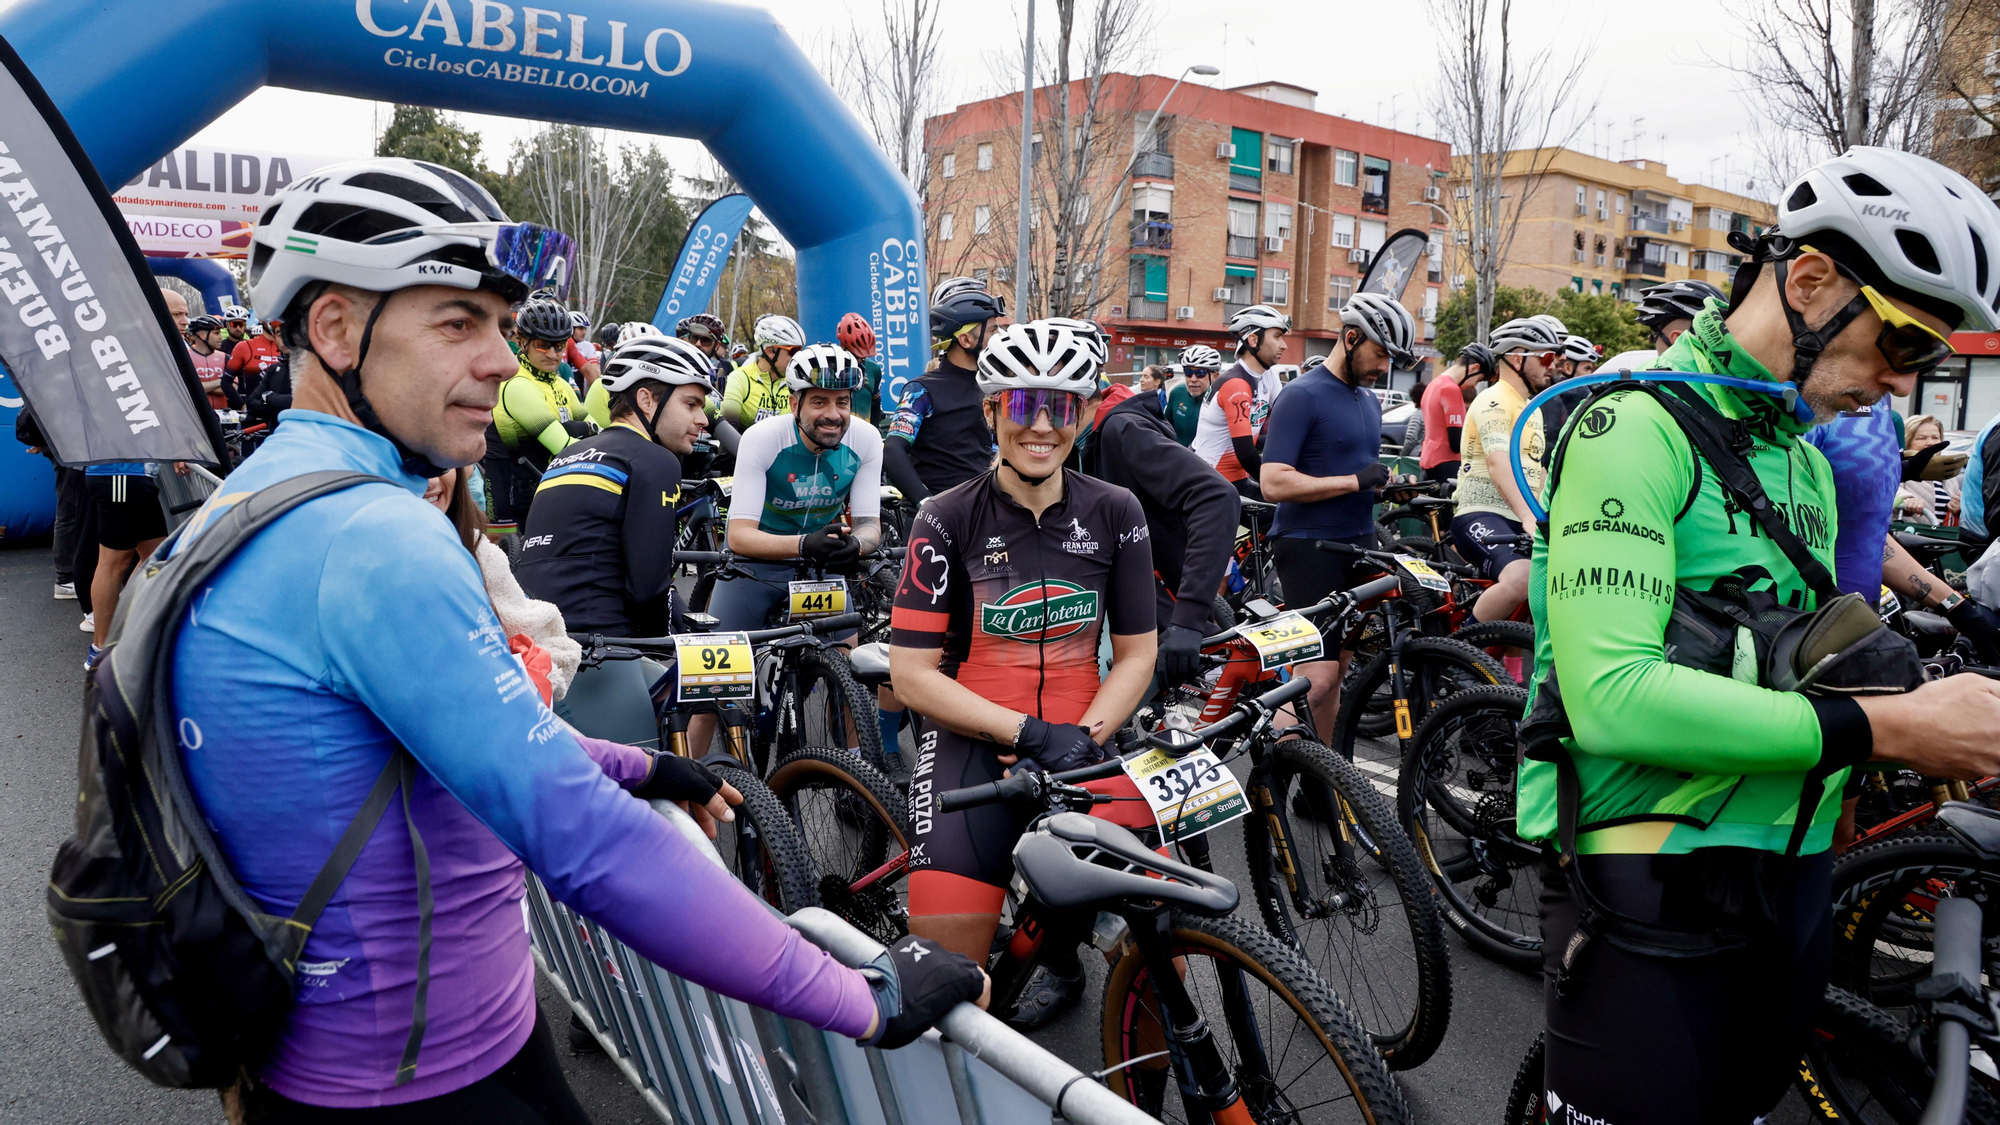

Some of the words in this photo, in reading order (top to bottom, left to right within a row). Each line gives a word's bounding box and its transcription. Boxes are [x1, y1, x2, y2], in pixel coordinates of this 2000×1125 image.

[355, 0, 692, 77] CABELLO
[384, 48, 650, 98] CiclosCABELLO.COM
[1861, 204, 1911, 223] KASK
[418, 264, 453, 276] KASK
[666, 224, 713, 316] CABELLO
[696, 231, 729, 288] Ciclos
[905, 239, 922, 326] Ciclos
[1081, 541, 1099, 550] POZO
[1562, 519, 1590, 537] BICIS
[1592, 519, 1666, 546] GRANADOS
[1551, 567, 1673, 605] AL-ANDALUS
[1559, 588, 1585, 601] CLUB
[1597, 586, 1660, 606] CICLISTA
[801, 594, 833, 611] 441
[1260, 623, 1303, 641] 552
[701, 647, 732, 670] 92
[918, 729, 938, 776] FRAN
[1140, 758, 1170, 775] PREFERENTE
[1149, 758, 1221, 802] 3373
[914, 779, 934, 836] POZO
[1216, 798, 1243, 813] Smilke
[908, 857, 932, 868] OXXI
[1277, 915, 1293, 943] SWISS
